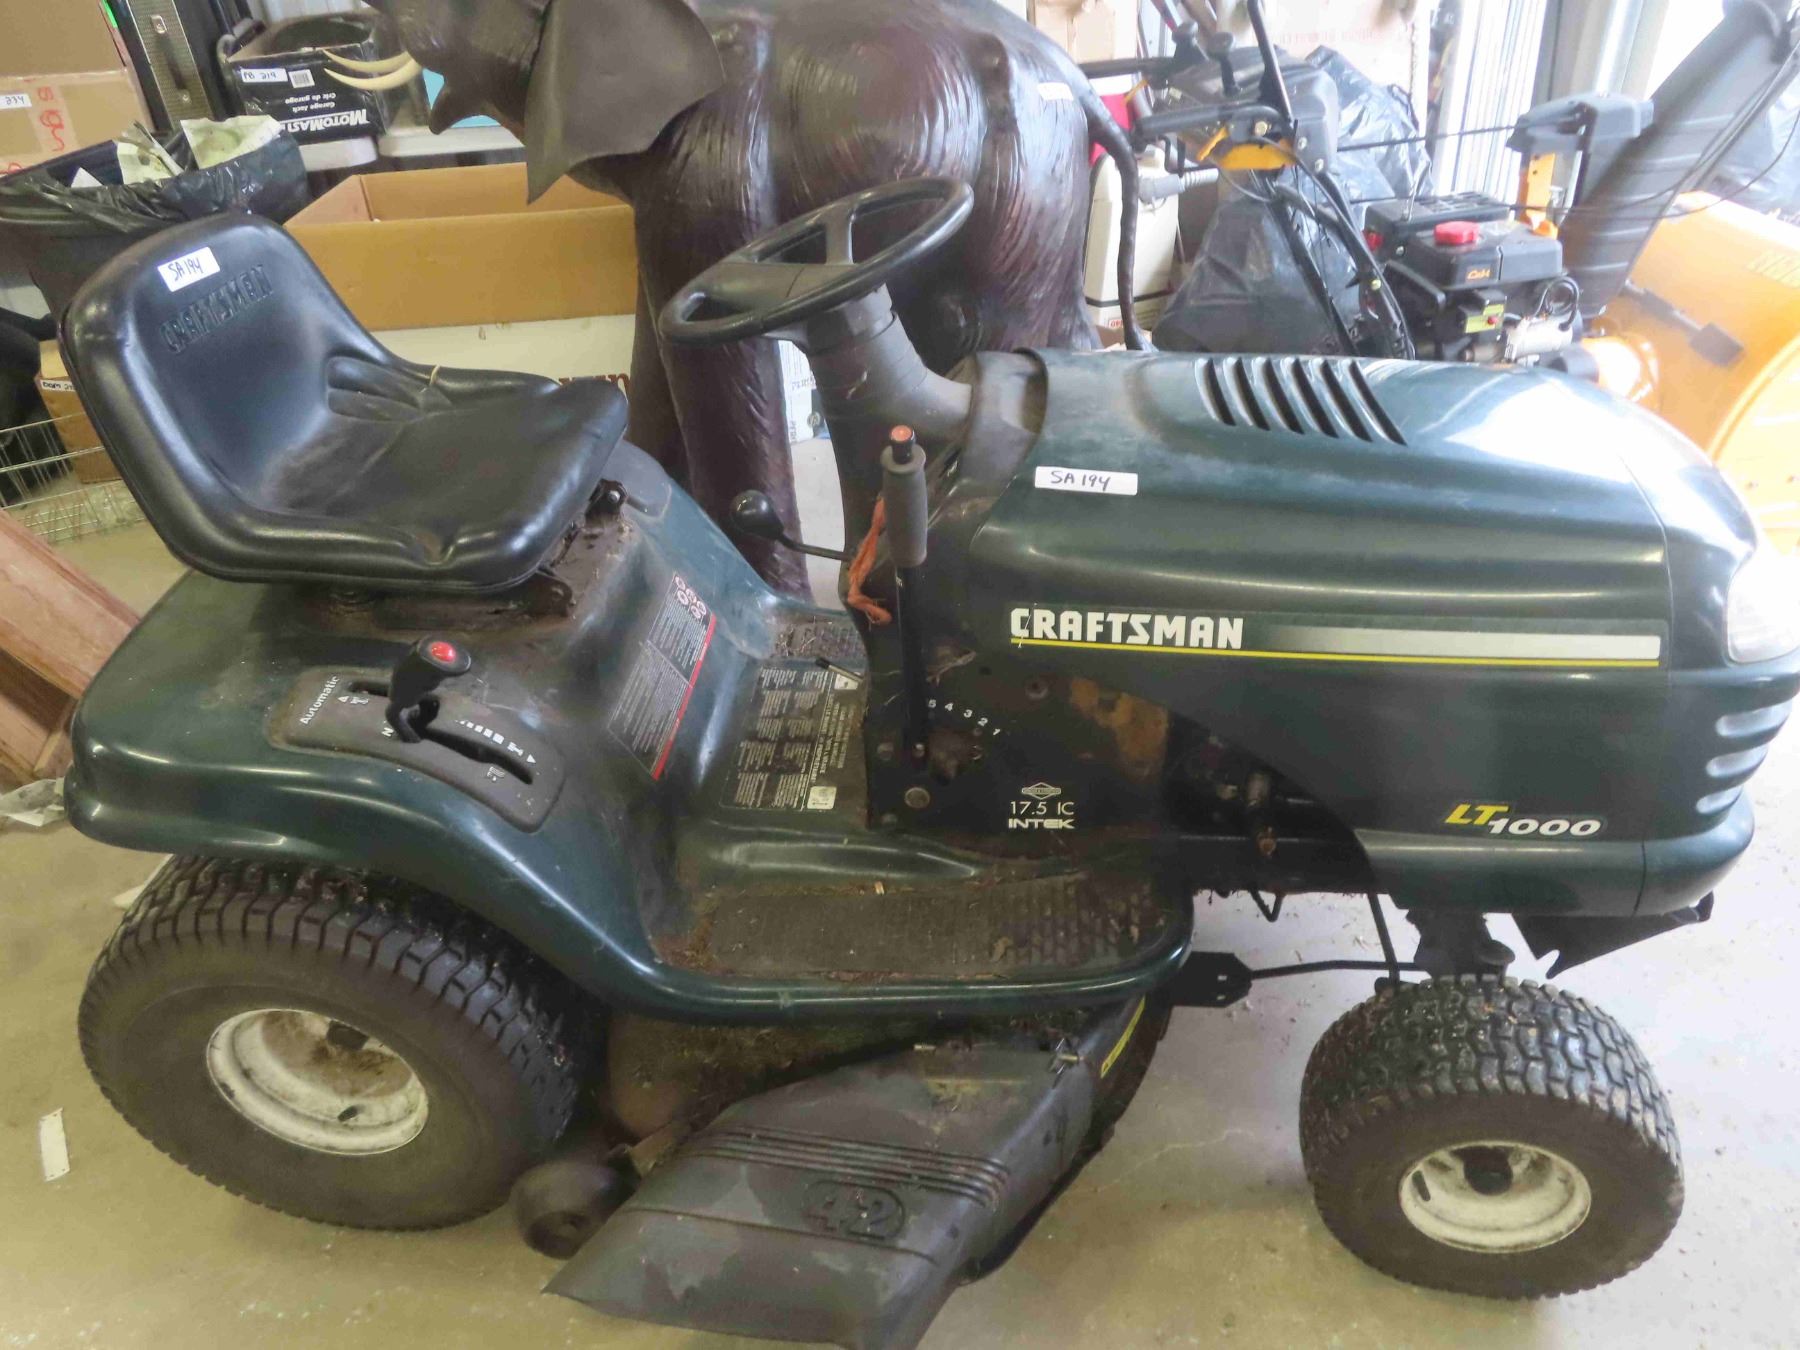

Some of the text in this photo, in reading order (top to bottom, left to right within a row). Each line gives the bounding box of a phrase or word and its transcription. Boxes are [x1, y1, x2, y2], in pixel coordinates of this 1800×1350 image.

[292, 102, 335, 112] Garage Jack
[1010, 607, 1244, 650] CRAFTSMAN
[300, 676, 340, 725] Automatic
[944, 702, 954, 712] 4
[963, 709, 973, 718] 3
[978, 717, 989, 727] 2
[993, 728, 1001, 736] 1
[1008, 818, 1075, 830] INTEK
[1010, 801, 1075, 816] 17.5 IC
[1444, 803, 1601, 836] LT 1000
